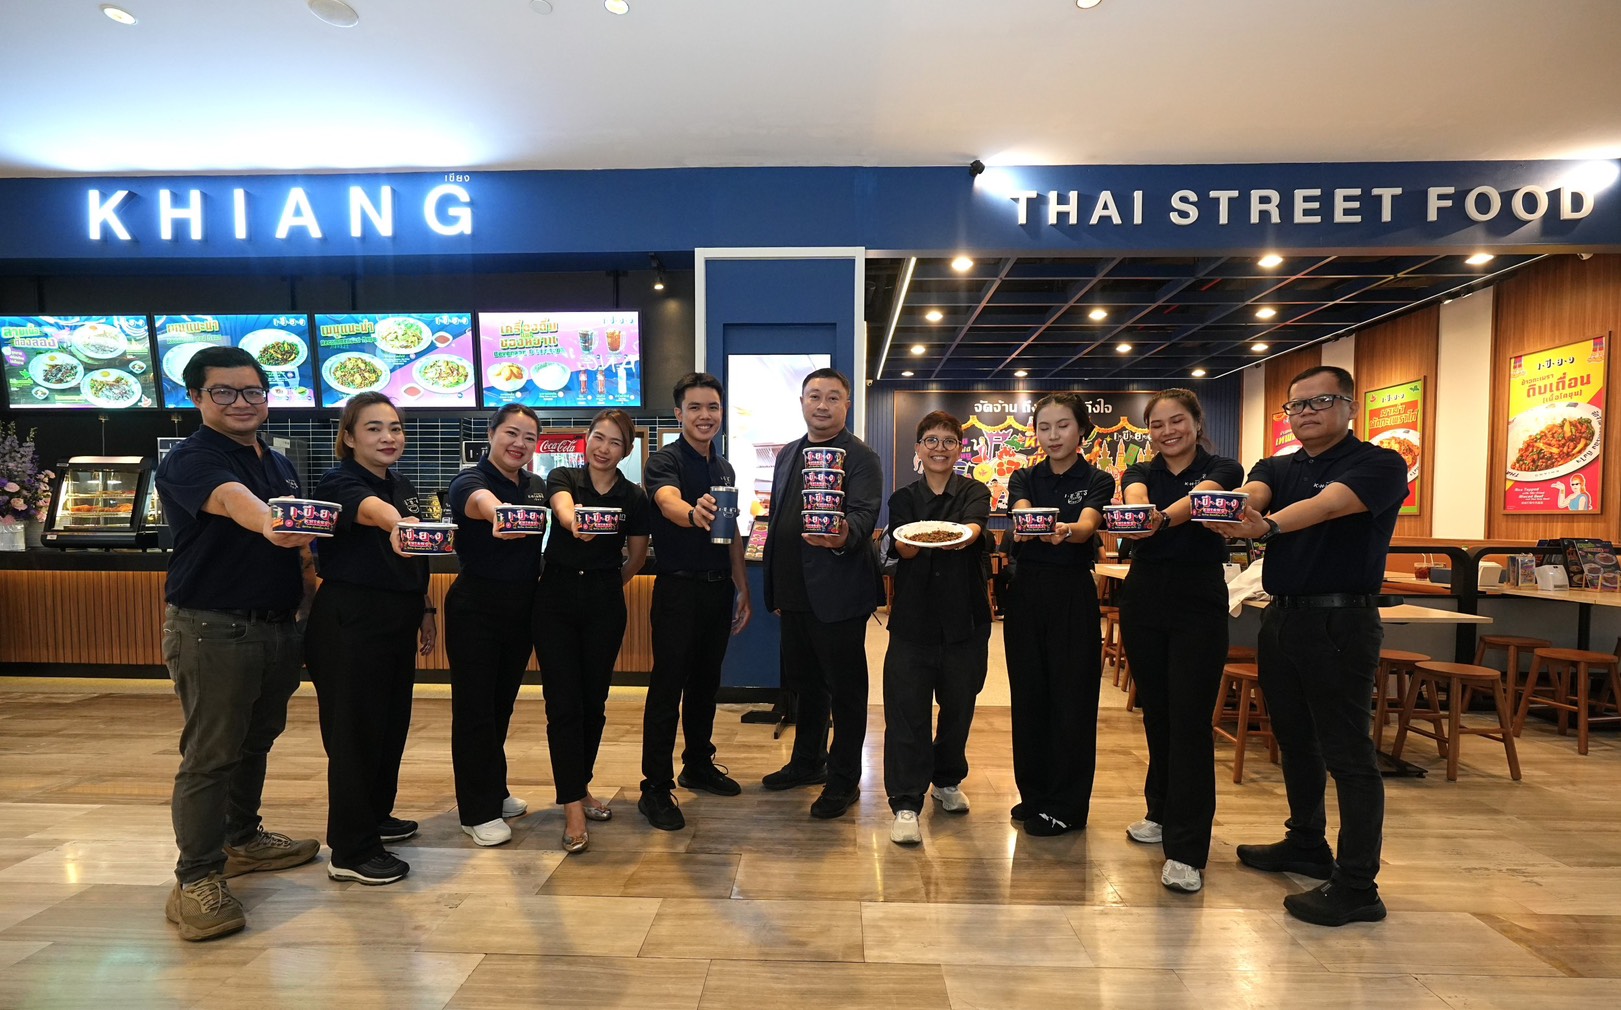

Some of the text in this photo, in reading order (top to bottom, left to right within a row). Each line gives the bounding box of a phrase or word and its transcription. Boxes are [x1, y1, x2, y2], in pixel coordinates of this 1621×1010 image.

[87, 185, 473, 241] KHIANG
[1012, 184, 1595, 227] THAI STREET FOOD
[1526, 371, 1591, 398] ดิบเถื่อน
[974, 400, 1018, 413] จัดจ้าน
